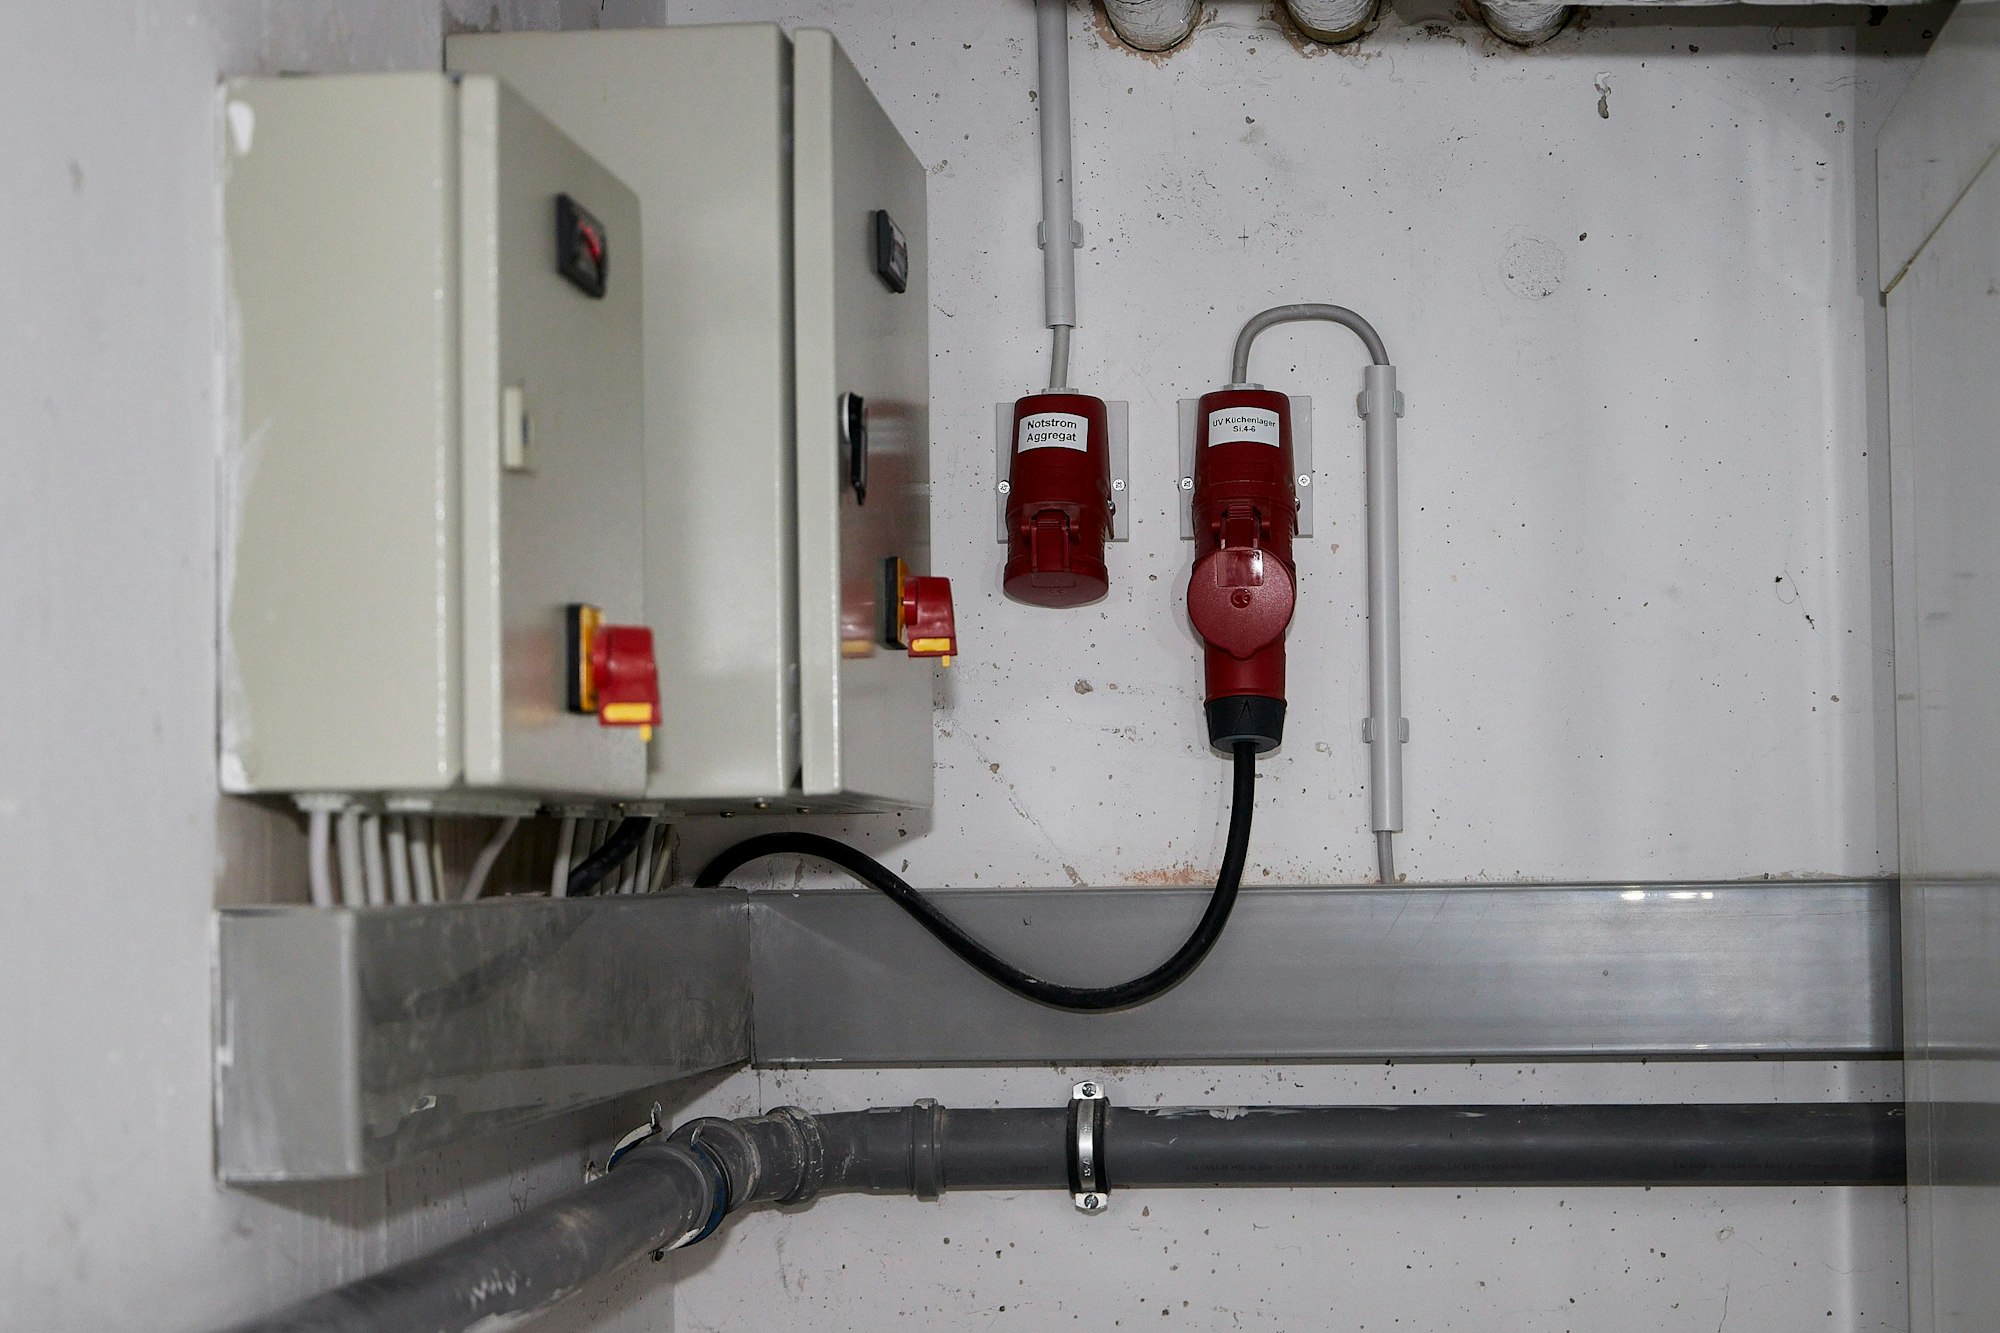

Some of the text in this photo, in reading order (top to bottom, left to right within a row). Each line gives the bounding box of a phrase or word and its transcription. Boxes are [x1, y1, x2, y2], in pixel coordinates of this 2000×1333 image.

[1027, 418, 1077, 430] Notstrom
[1212, 416, 1276, 427] UV Küchenlager
[1026, 432, 1077, 443] Aggregat
